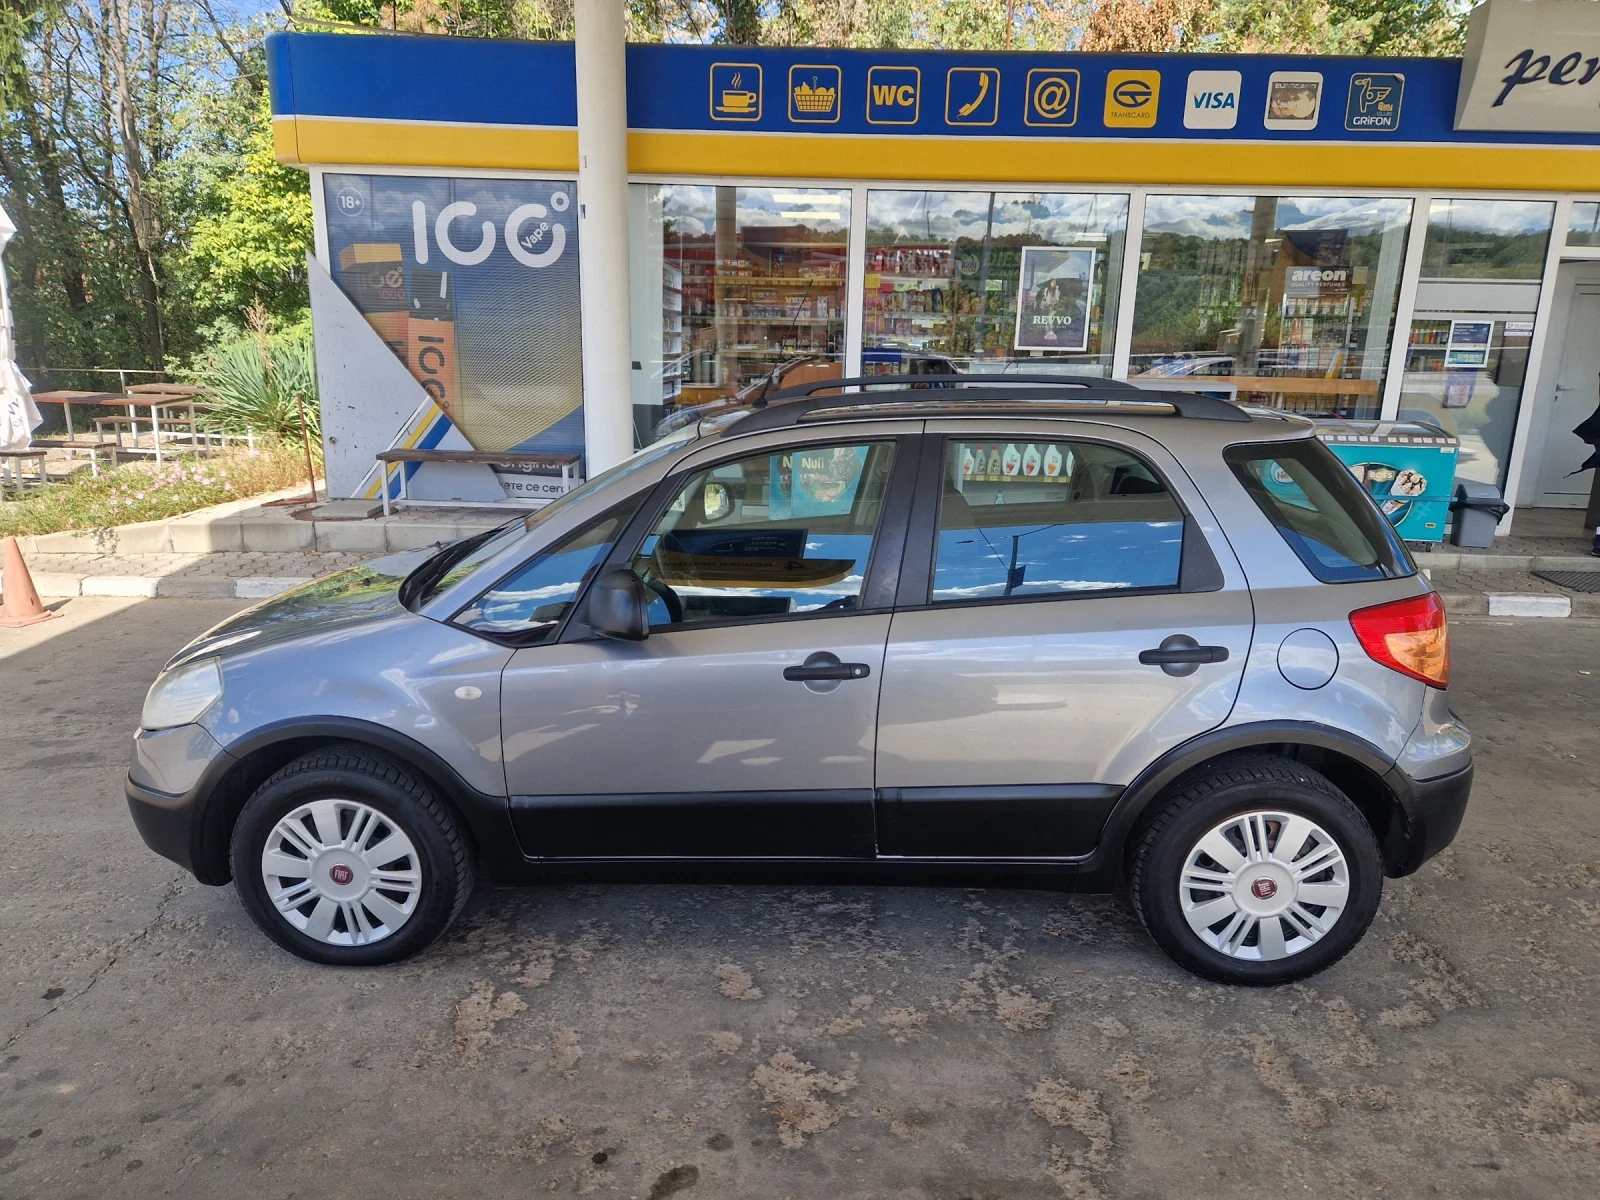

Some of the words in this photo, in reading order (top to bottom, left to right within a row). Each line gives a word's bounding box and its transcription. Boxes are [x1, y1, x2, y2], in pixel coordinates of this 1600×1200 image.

[872, 84, 915, 107] WC
[1193, 92, 1235, 109] VISA
[1110, 111, 1151, 119] TRANSCARD
[340, 195, 361, 209] 18+
[520, 221, 549, 251] Vape
[1291, 270, 1347, 282] areon
[1032, 315, 1072, 325] REVVO
[334, 869, 348, 880] FIAT
